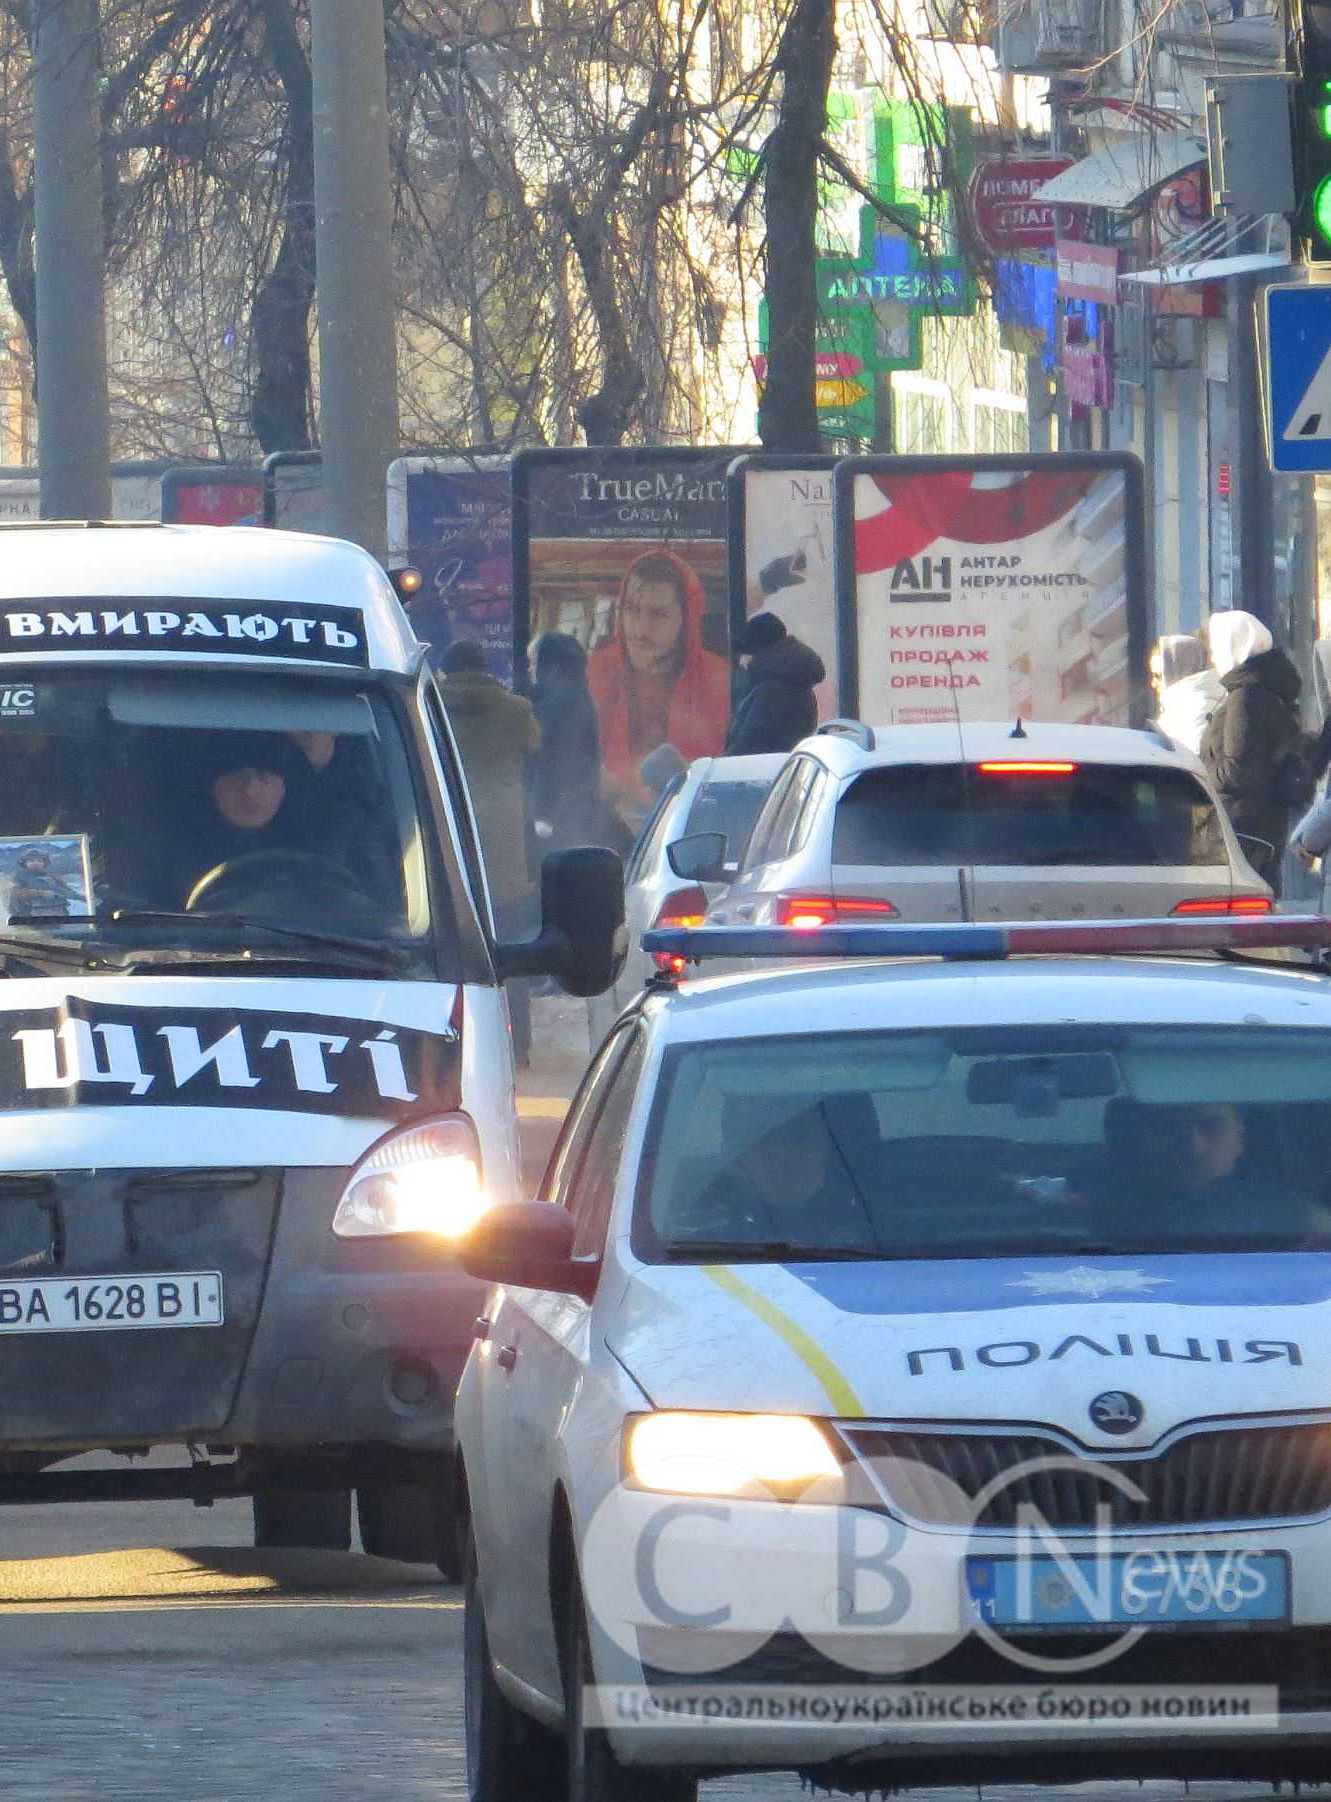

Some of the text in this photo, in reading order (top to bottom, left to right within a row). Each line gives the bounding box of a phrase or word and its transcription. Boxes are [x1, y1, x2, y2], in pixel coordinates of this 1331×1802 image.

[890, 556, 952, 590] АН
[960, 556, 1022, 569] АНТАР
[960, 573, 1087, 589] НЕРУХОМІСТЬ
[3, 611, 359, 649] ВМИРАЮТЬ
[890, 625, 987, 639] КУПІВЛЯ
[890, 650, 989, 665] ПРОДАЖ
[890, 674, 981, 689] ОРЕНДА
[10, 1016, 419, 1102] ЩИТІ
[64, 1283, 146, 1321] 1628
[156, 1280, 201, 1319] BI
[906, 1333, 1304, 1377] ПОЛІЦІЯ
